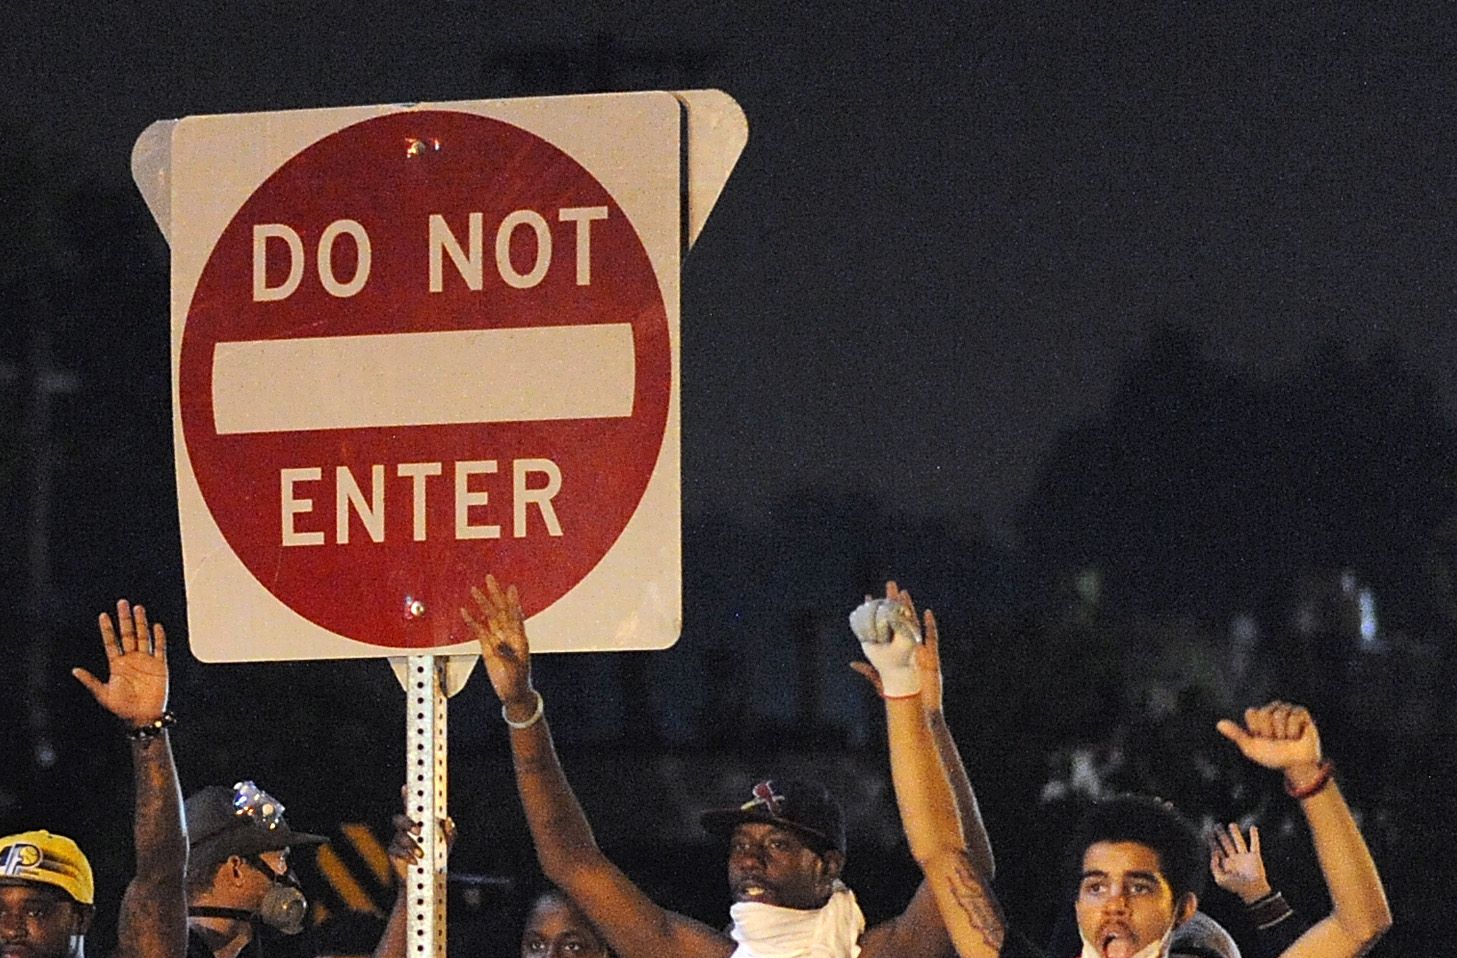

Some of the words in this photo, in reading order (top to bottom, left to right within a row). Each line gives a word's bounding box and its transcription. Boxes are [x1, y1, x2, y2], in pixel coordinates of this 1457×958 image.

[251, 218, 372, 302] DO
[428, 206, 609, 293] NOT
[279, 458, 563, 547] ENTER
